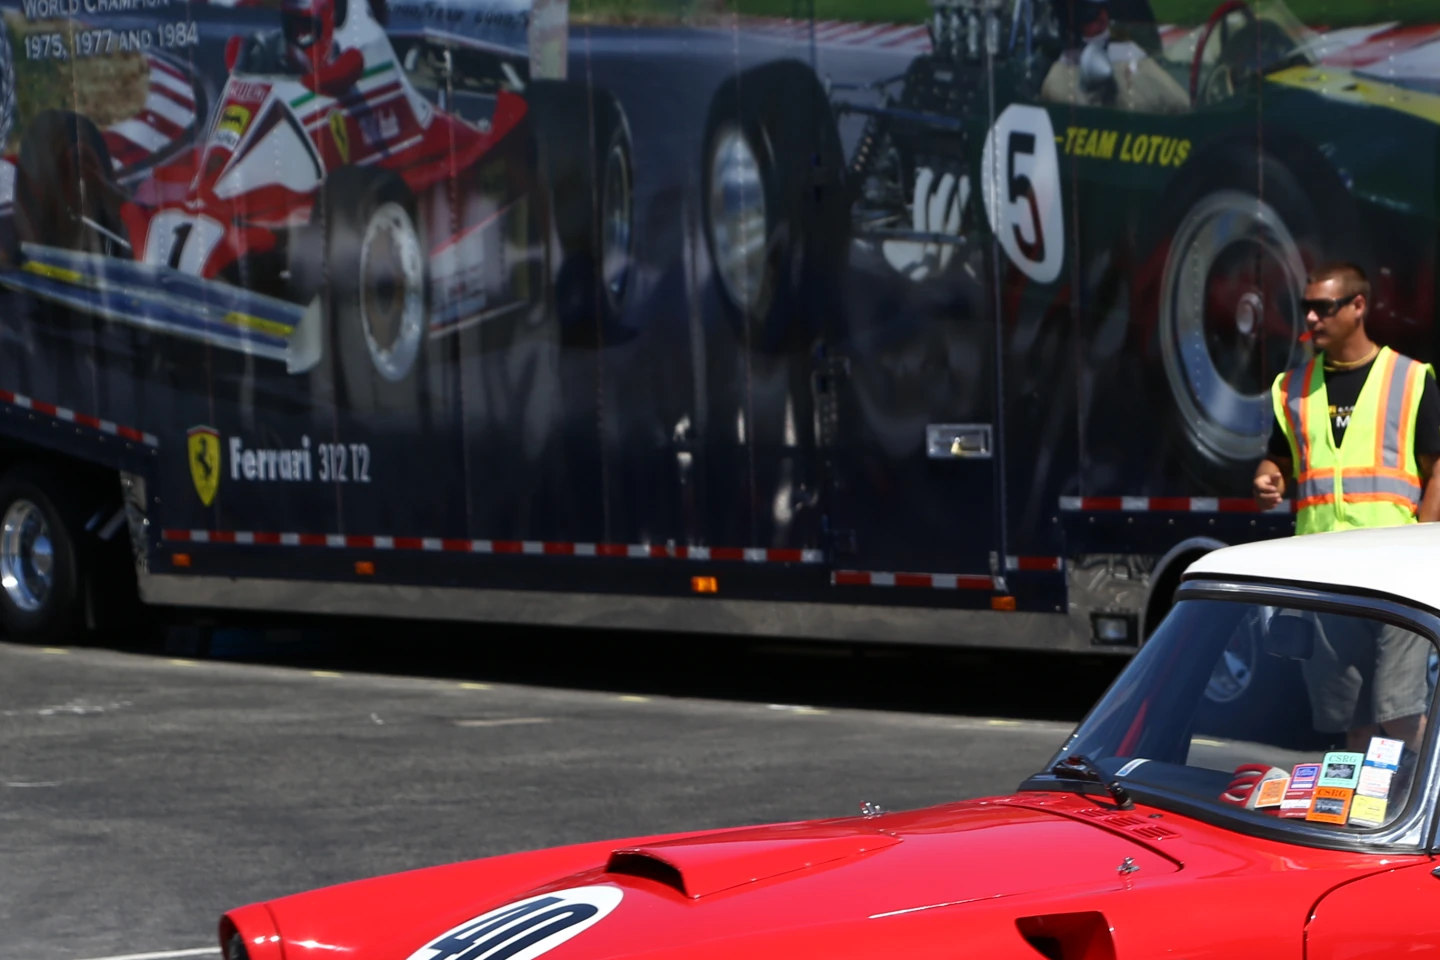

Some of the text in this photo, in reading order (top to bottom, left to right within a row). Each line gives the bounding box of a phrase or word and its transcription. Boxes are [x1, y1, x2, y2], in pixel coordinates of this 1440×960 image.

[24, 20, 200, 60] 1975, 1977 AND 1984
[1064, 126, 1192, 167] TEAM LOTUS
[1007, 131, 1046, 264] 5
[167, 222, 193, 269] 1
[229, 433, 313, 482] Ferrari
[1328, 754, 1358, 763] CSRG
[1317, 788, 1347, 798] CSRG
